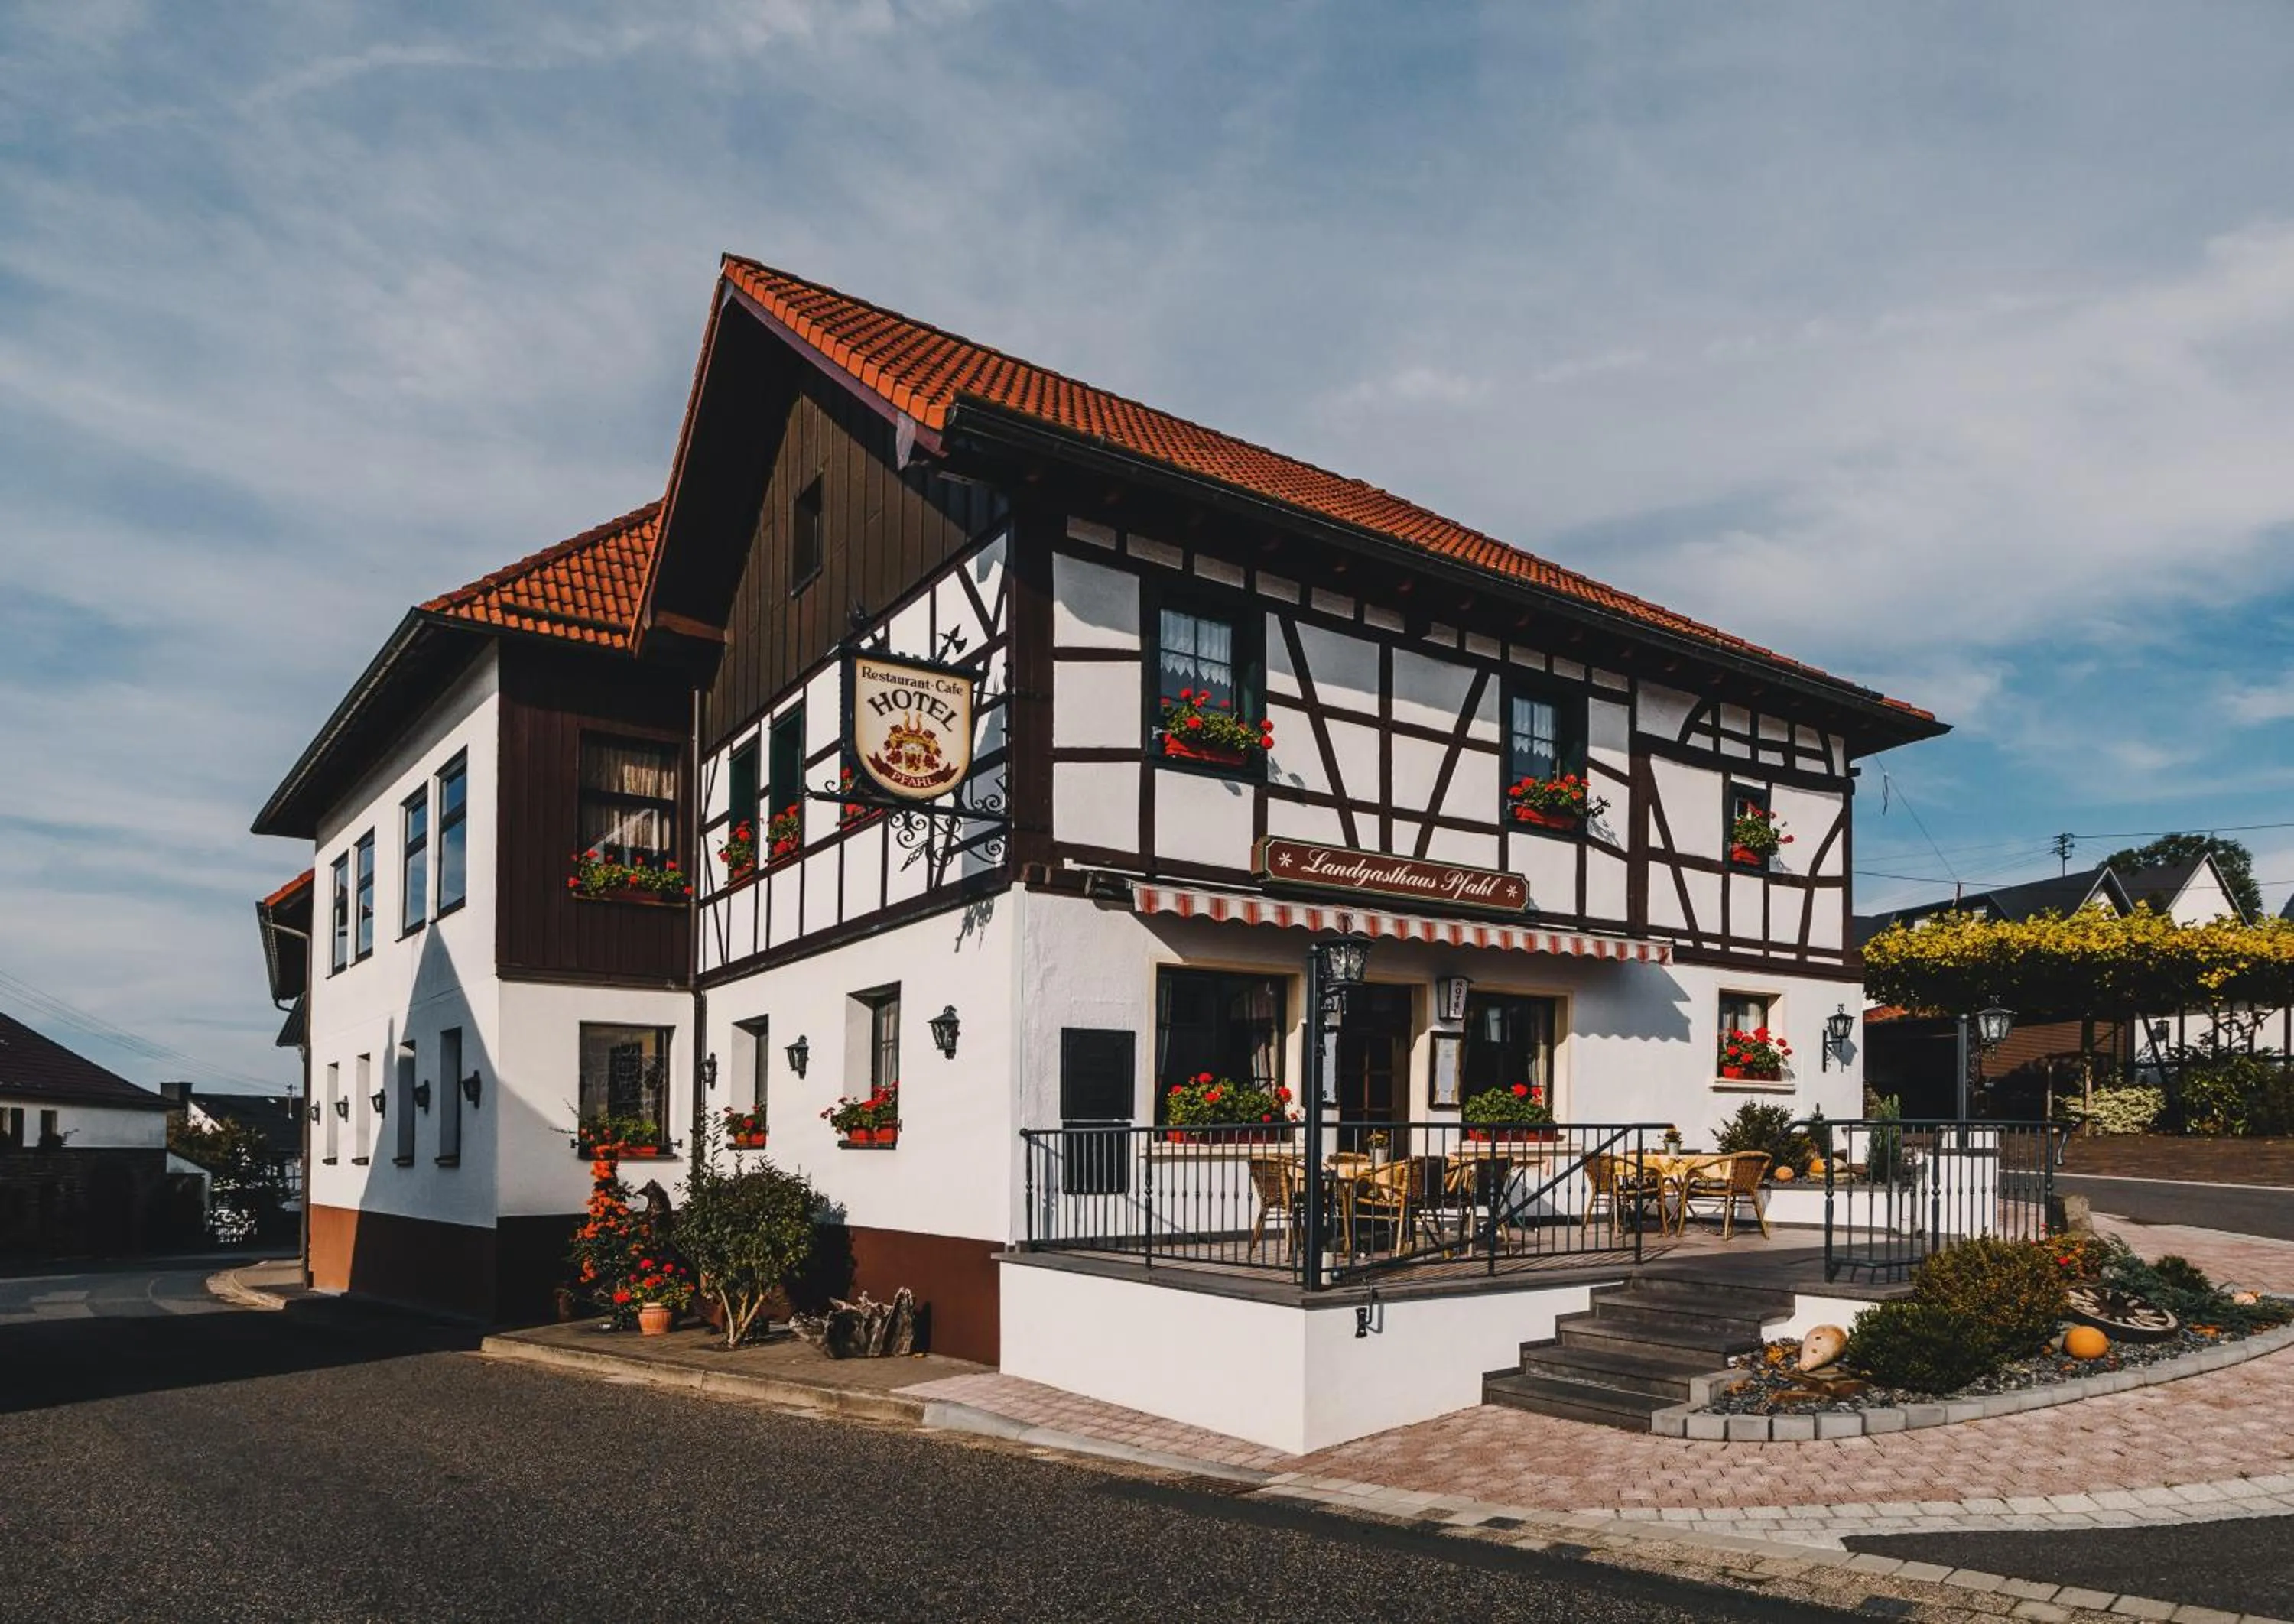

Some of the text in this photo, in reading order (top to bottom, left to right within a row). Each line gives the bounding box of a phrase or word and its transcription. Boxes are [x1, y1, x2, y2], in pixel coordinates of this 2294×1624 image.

[867, 689, 957, 732] HOTEL
[891, 771, 937, 787] PFAHL
[1301, 849, 1501, 899] Landgasthaus Pfahl
